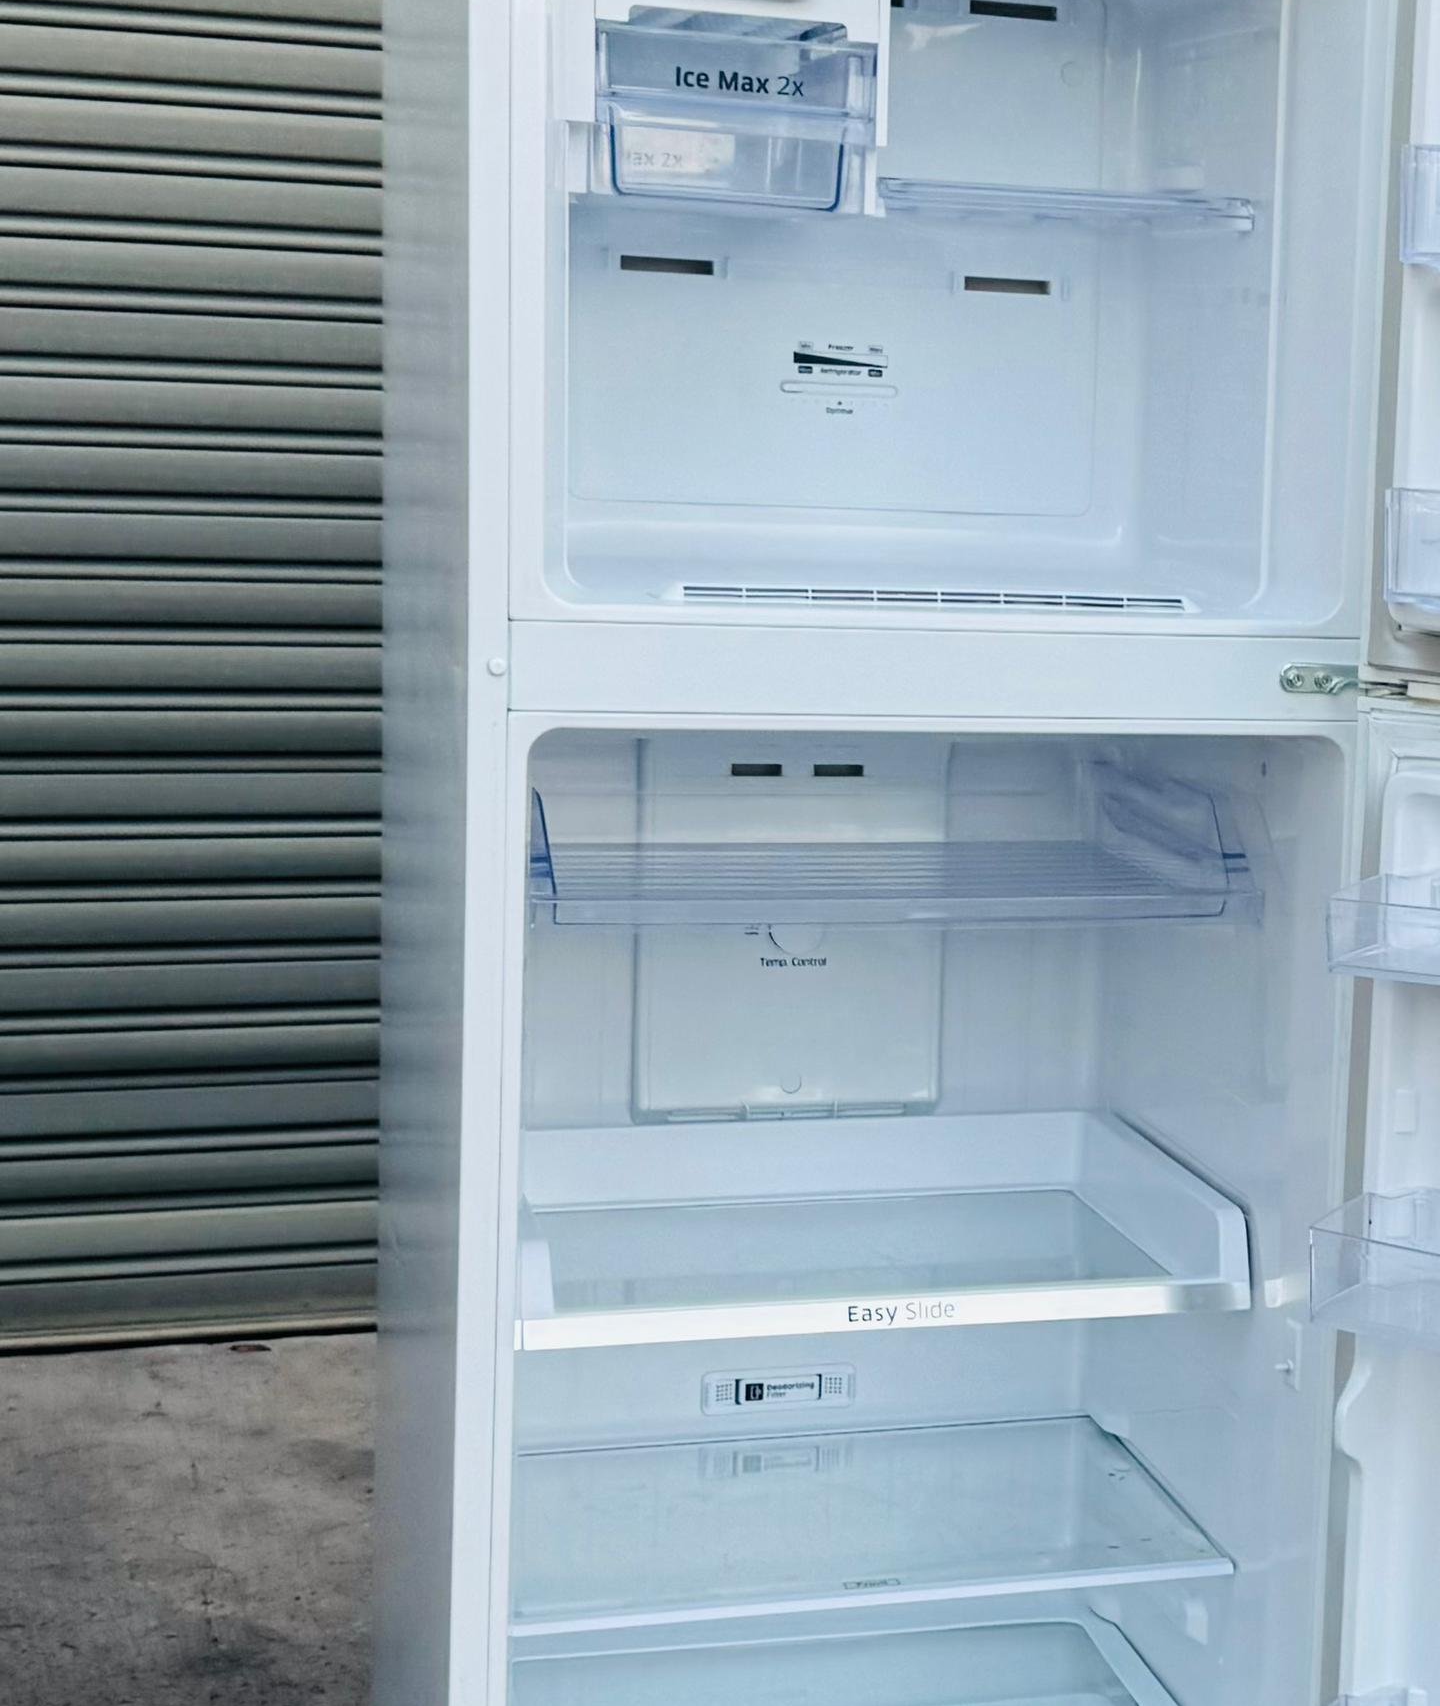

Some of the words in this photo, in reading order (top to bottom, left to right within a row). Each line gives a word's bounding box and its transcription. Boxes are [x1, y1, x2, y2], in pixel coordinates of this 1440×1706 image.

[675, 66, 710, 89] Ice
[718, 70, 770, 94] Max
[776, 76, 804, 97] 2x
[791, 957, 828, 967] Control
[848, 1305, 898, 1326] Easy
[905, 1300, 955, 1321] Slide
[766, 1381, 815, 1391] Deodorizing
